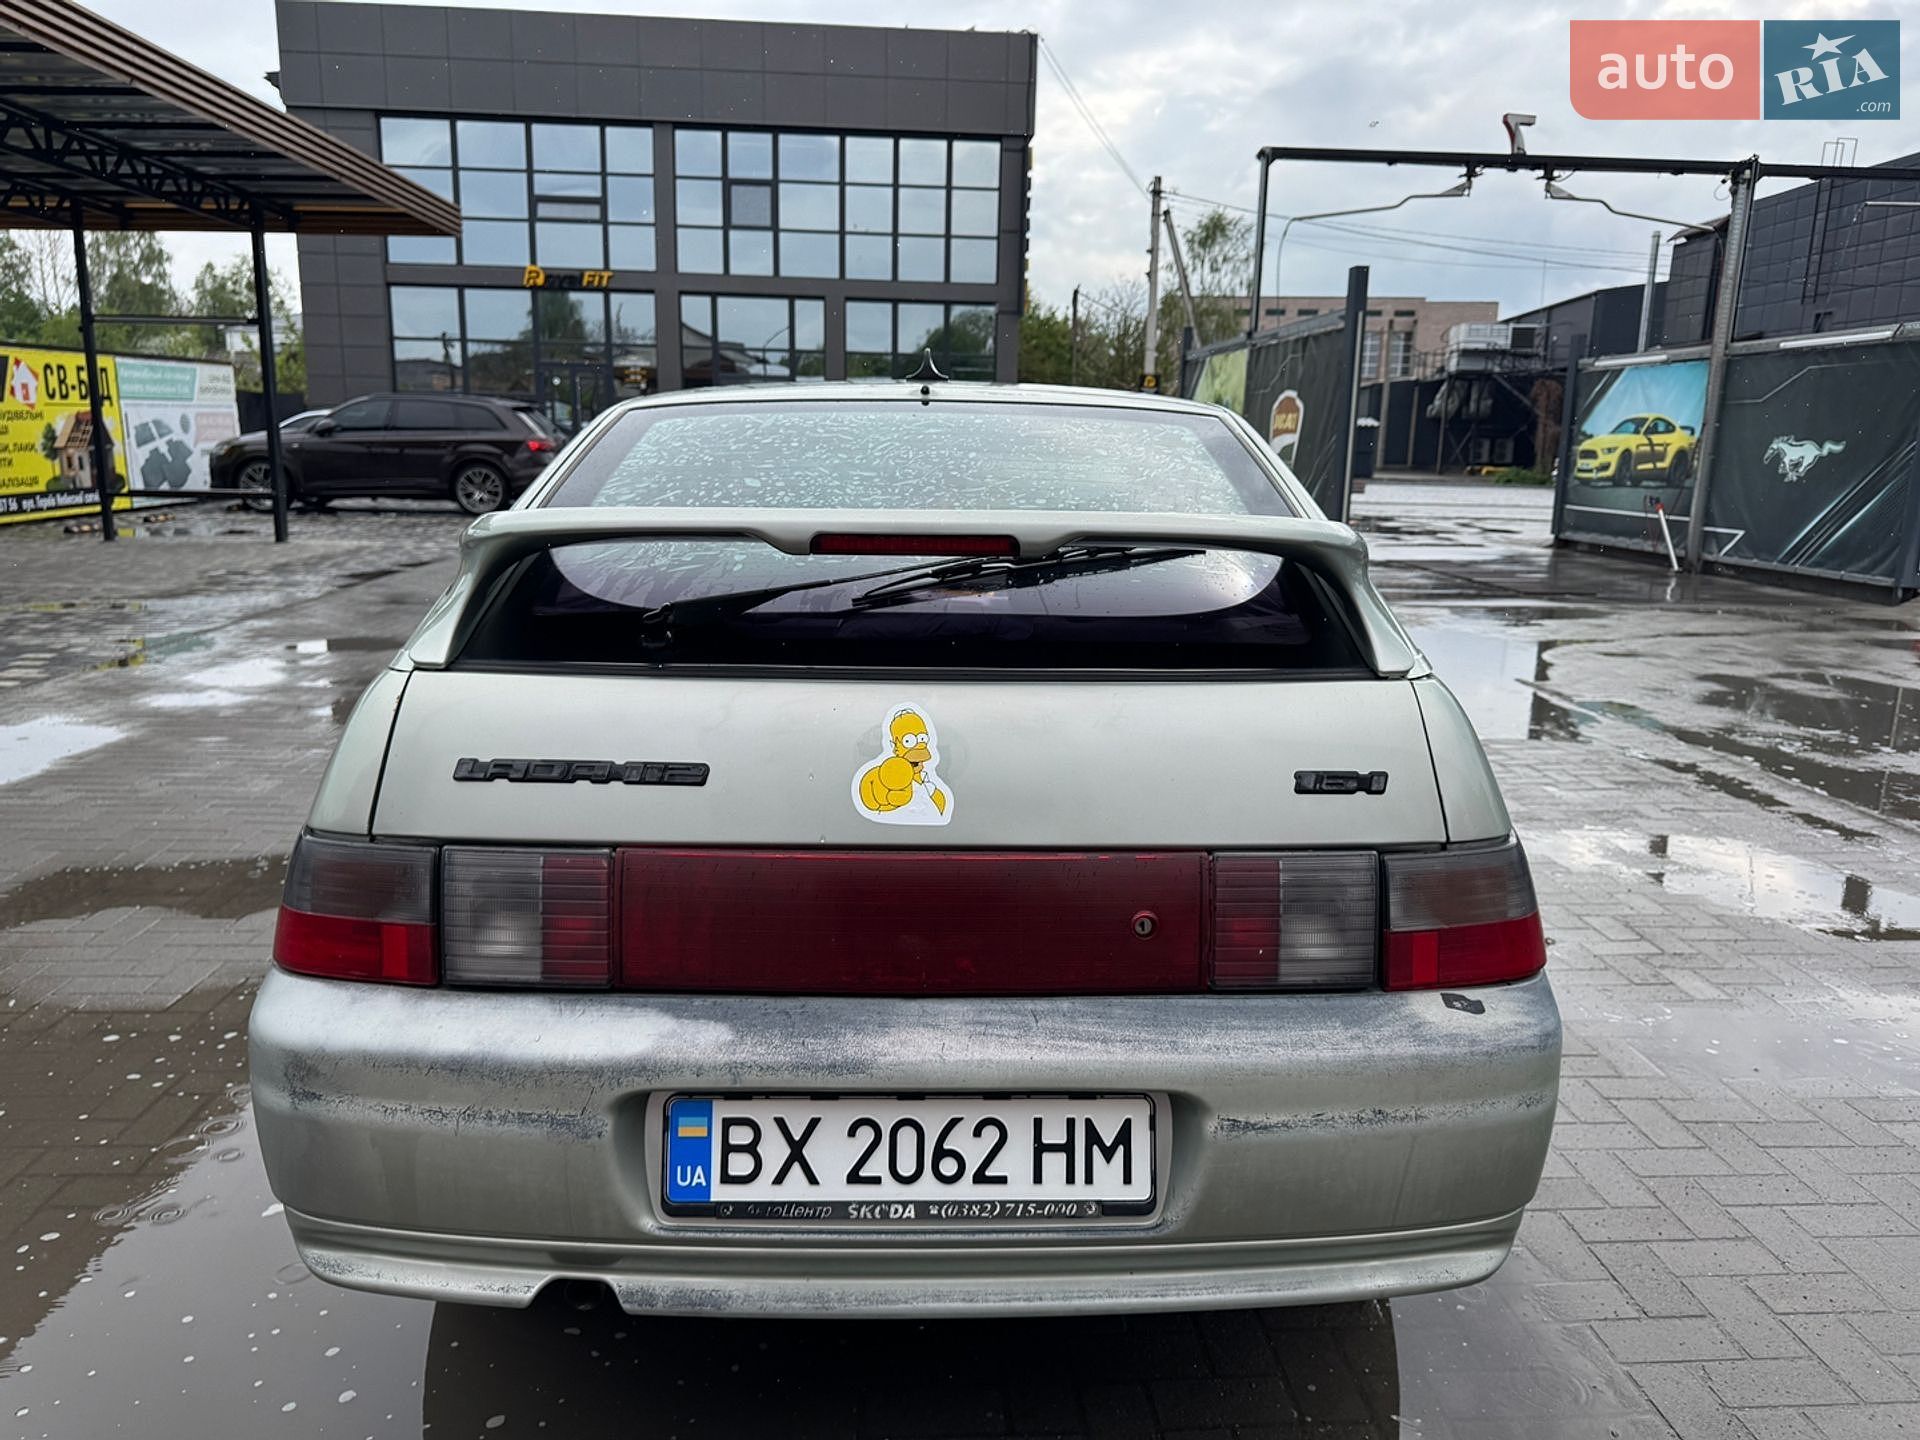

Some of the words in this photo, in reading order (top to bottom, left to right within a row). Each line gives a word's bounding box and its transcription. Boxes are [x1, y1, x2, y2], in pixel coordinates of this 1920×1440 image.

[43, 363, 114, 407] СВ-БД
[720, 1116, 822, 1185] BX
[846, 1116, 1009, 1185] 2062
[1033, 1116, 1133, 1185] HM
[676, 1164, 707, 1187] UA
